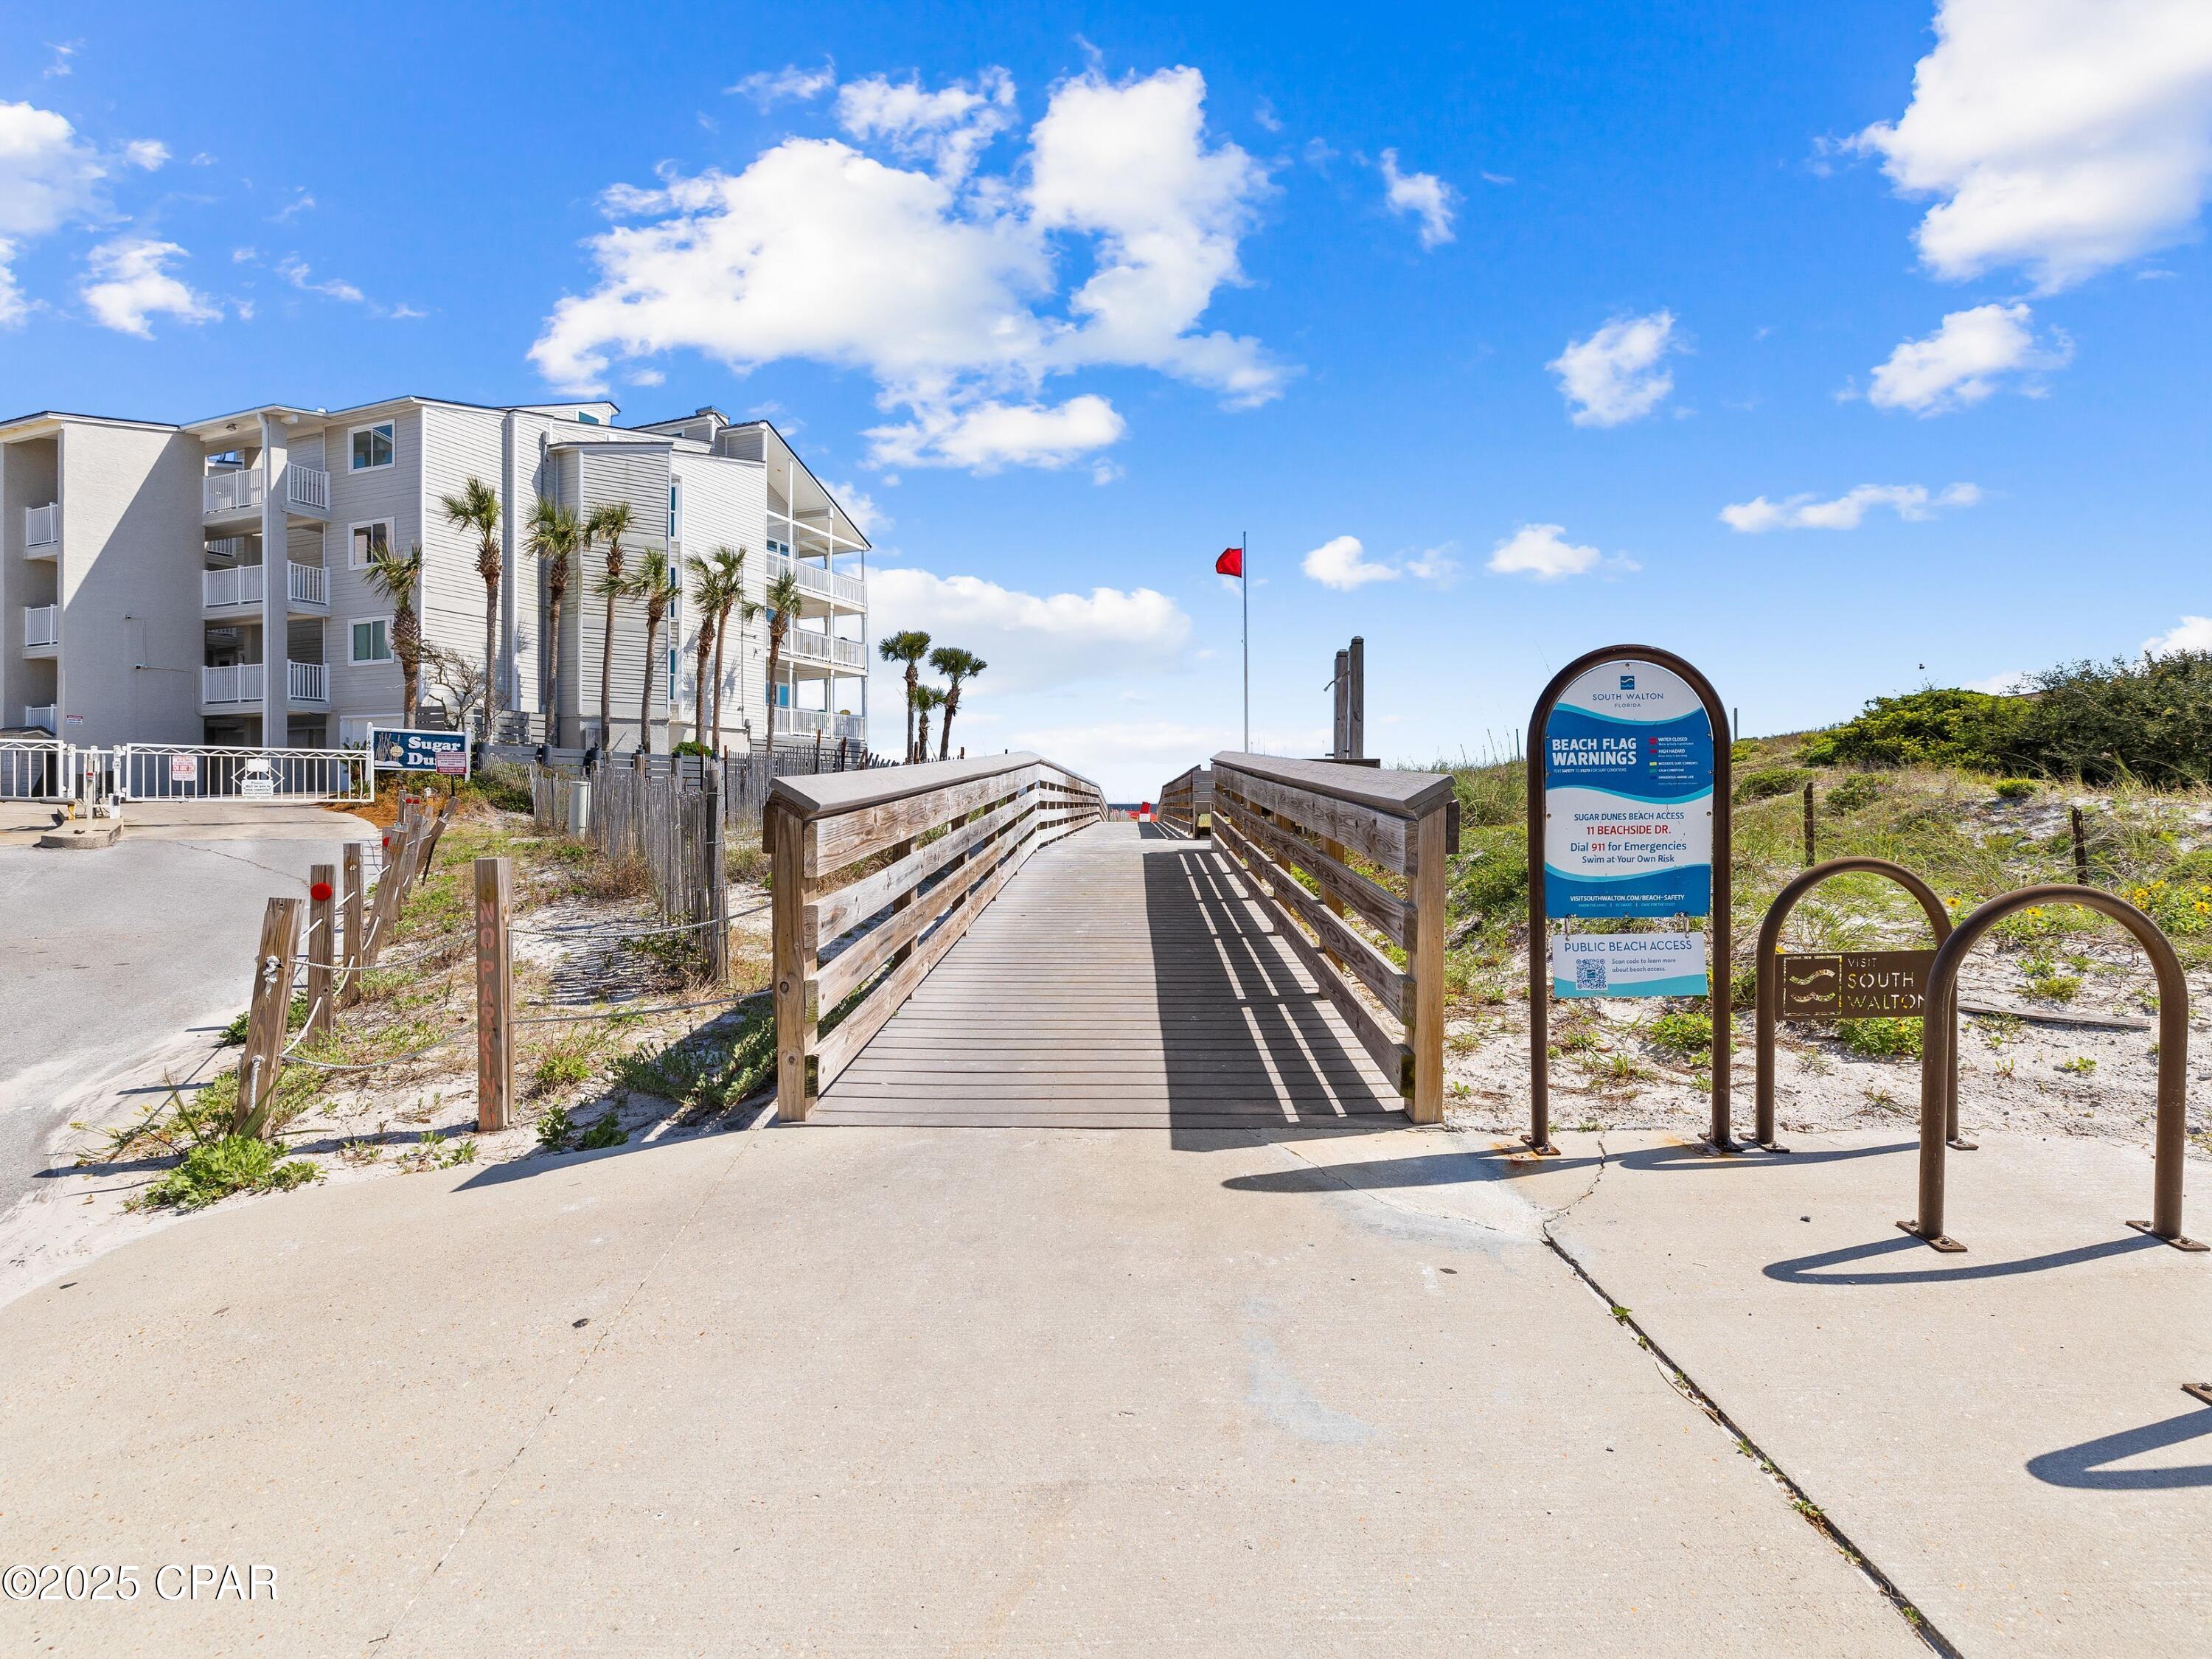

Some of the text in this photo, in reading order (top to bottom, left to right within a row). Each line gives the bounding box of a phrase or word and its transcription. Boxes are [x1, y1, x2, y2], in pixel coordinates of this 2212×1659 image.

[1593, 692, 1663, 701] SOUTH WALTON
[408, 737, 461, 752] Sugar
[1552, 737, 1637, 751] BEACH FLAG
[1552, 751, 1637, 766] WARNINGS
[1601, 813, 1627, 821] DUNES
[1656, 812, 1684, 820] ACCESS
[1587, 825, 1671, 835] 11 BEACHSIDE DR.
[1571, 841, 1687, 853] Dial 911 for Emergencies
[1582, 855, 1604, 863] Swim
[1658, 854, 1674, 863] Risk
[480, 899, 495, 950] NO
[1565, 940, 1692, 952] PUBLIC BEACH ACCESS
[1847, 958, 1877, 967] VISIT
[1847, 972, 1914, 989] SOUTH
